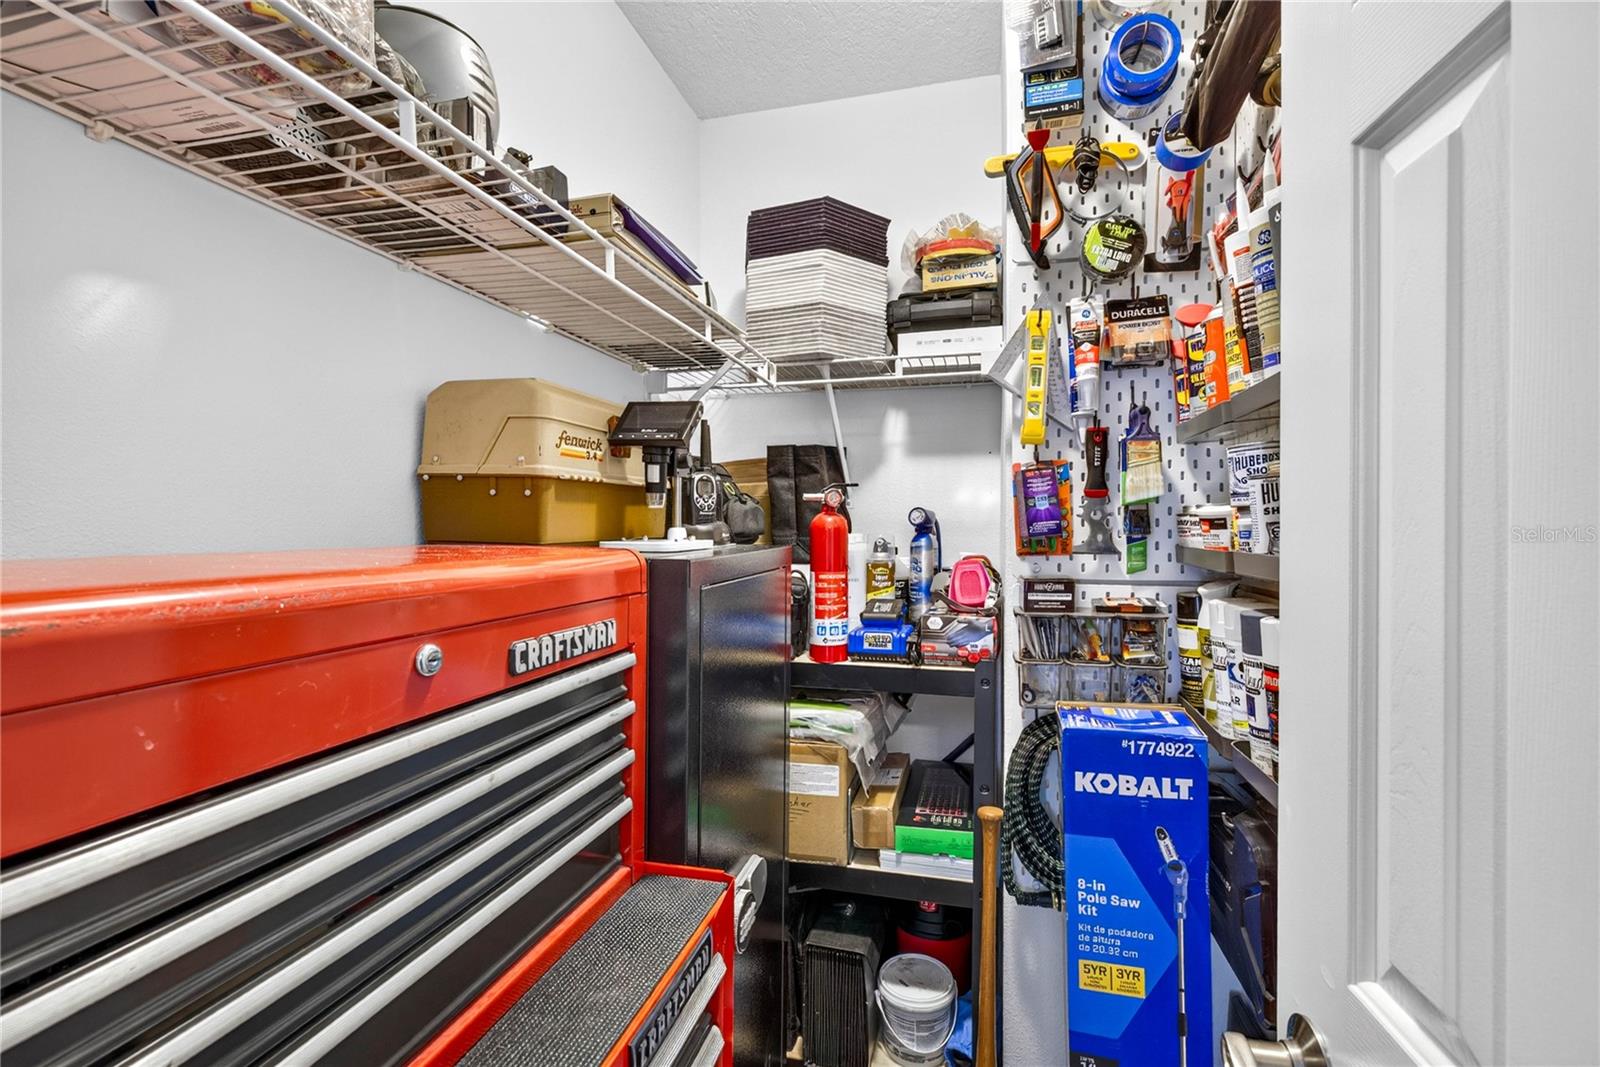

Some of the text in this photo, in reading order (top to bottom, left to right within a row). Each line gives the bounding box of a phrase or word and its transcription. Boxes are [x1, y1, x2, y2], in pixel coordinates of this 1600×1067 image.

[1111, 306, 1165, 320] DURACELL
[555, 430, 602, 451] fenwick
[1234, 452, 1280, 470] HUBERD'S
[1246, 466, 1268, 477] SHO
[514, 620, 617, 674] CRAFTSMAN
[1122, 739, 1194, 758] #1774922
[1074, 771, 1193, 800] KOBALT
[1078, 891, 1140, 909] Pole Saw
[1078, 904, 1098, 916] Kit
[1078, 923, 1091, 932] Kit
[1093, 924, 1105, 934] de
[1078, 934, 1121, 946] de altura
[1078, 943, 1090, 952] de
[1122, 950, 1139, 958] cm
[1083, 963, 1141, 981] 5YR 3YR
